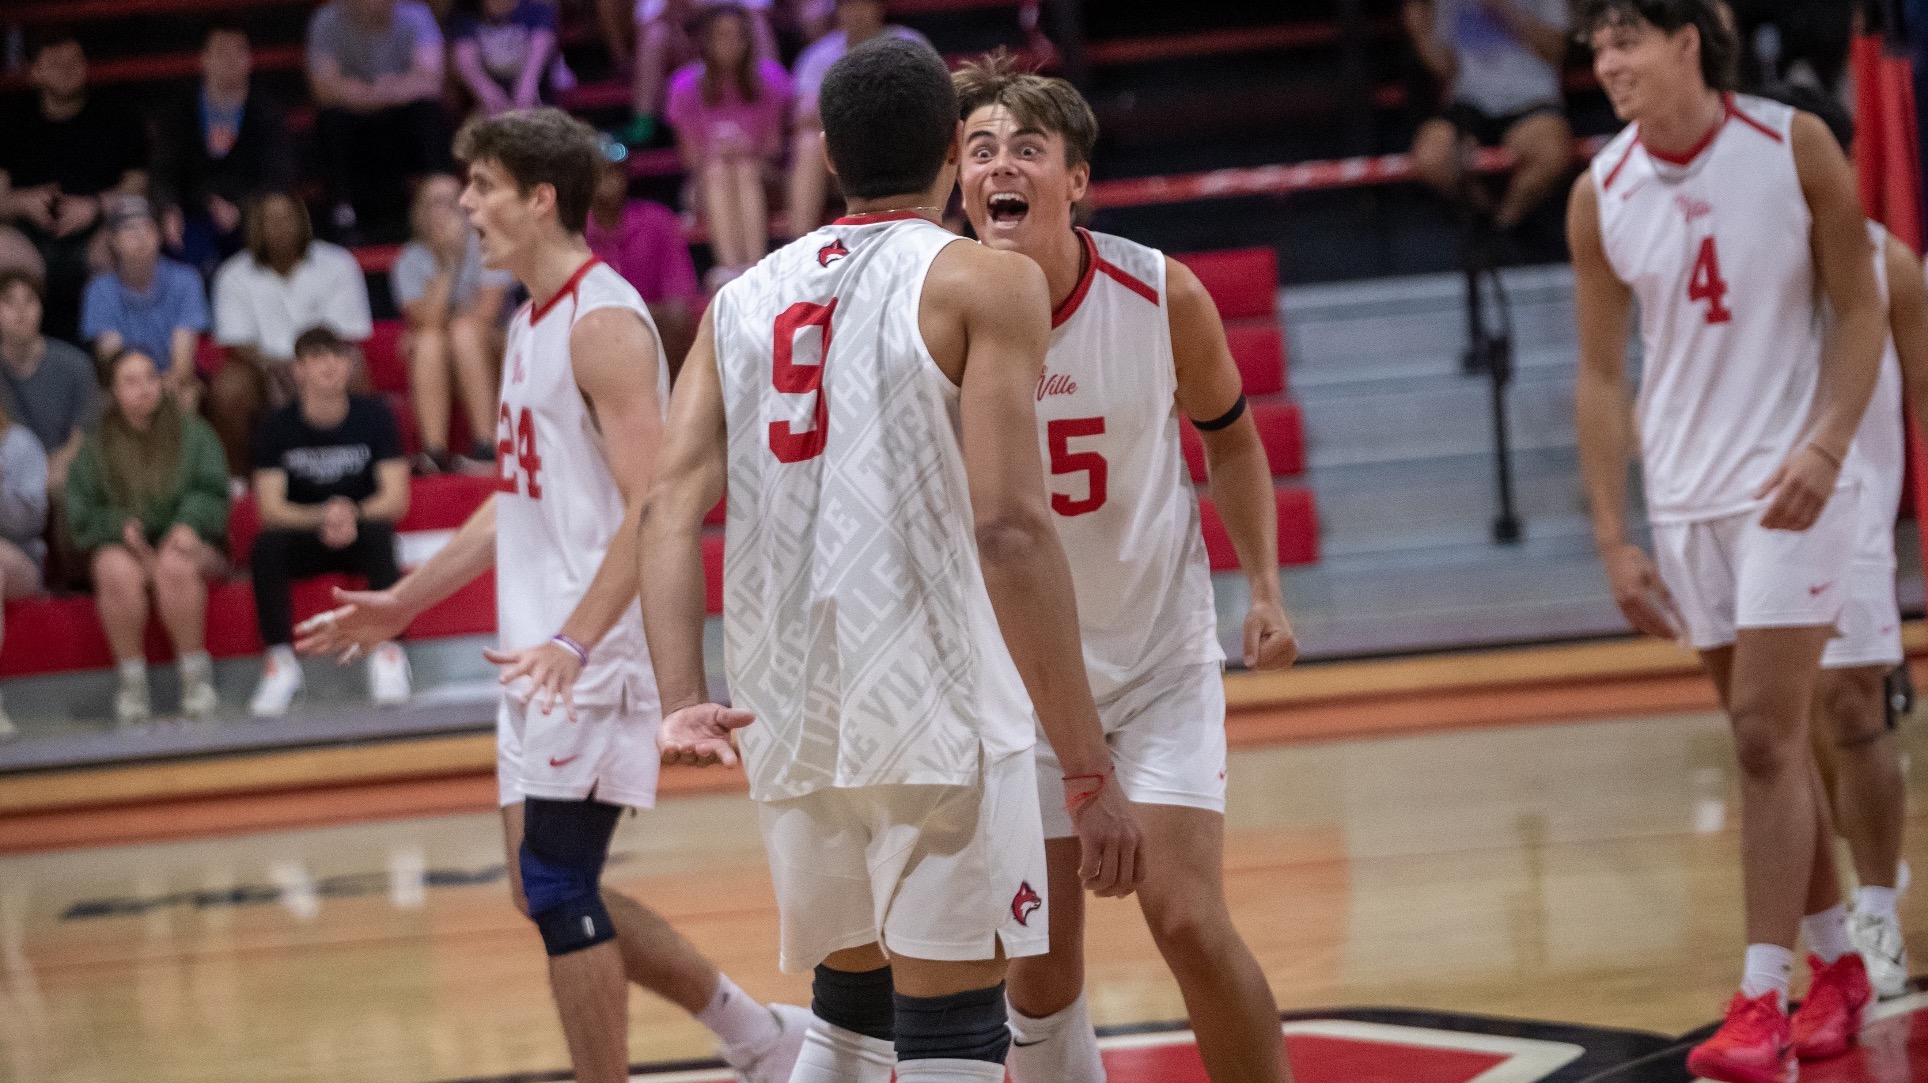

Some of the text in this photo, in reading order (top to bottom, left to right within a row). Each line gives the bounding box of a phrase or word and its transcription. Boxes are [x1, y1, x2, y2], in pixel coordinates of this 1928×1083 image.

[1687, 235, 1732, 325] 4
[768, 297, 839, 464] 9
[1037, 373, 1078, 401] Ville
[498, 401, 542, 500] 24
[1048, 416, 1108, 517] 5
